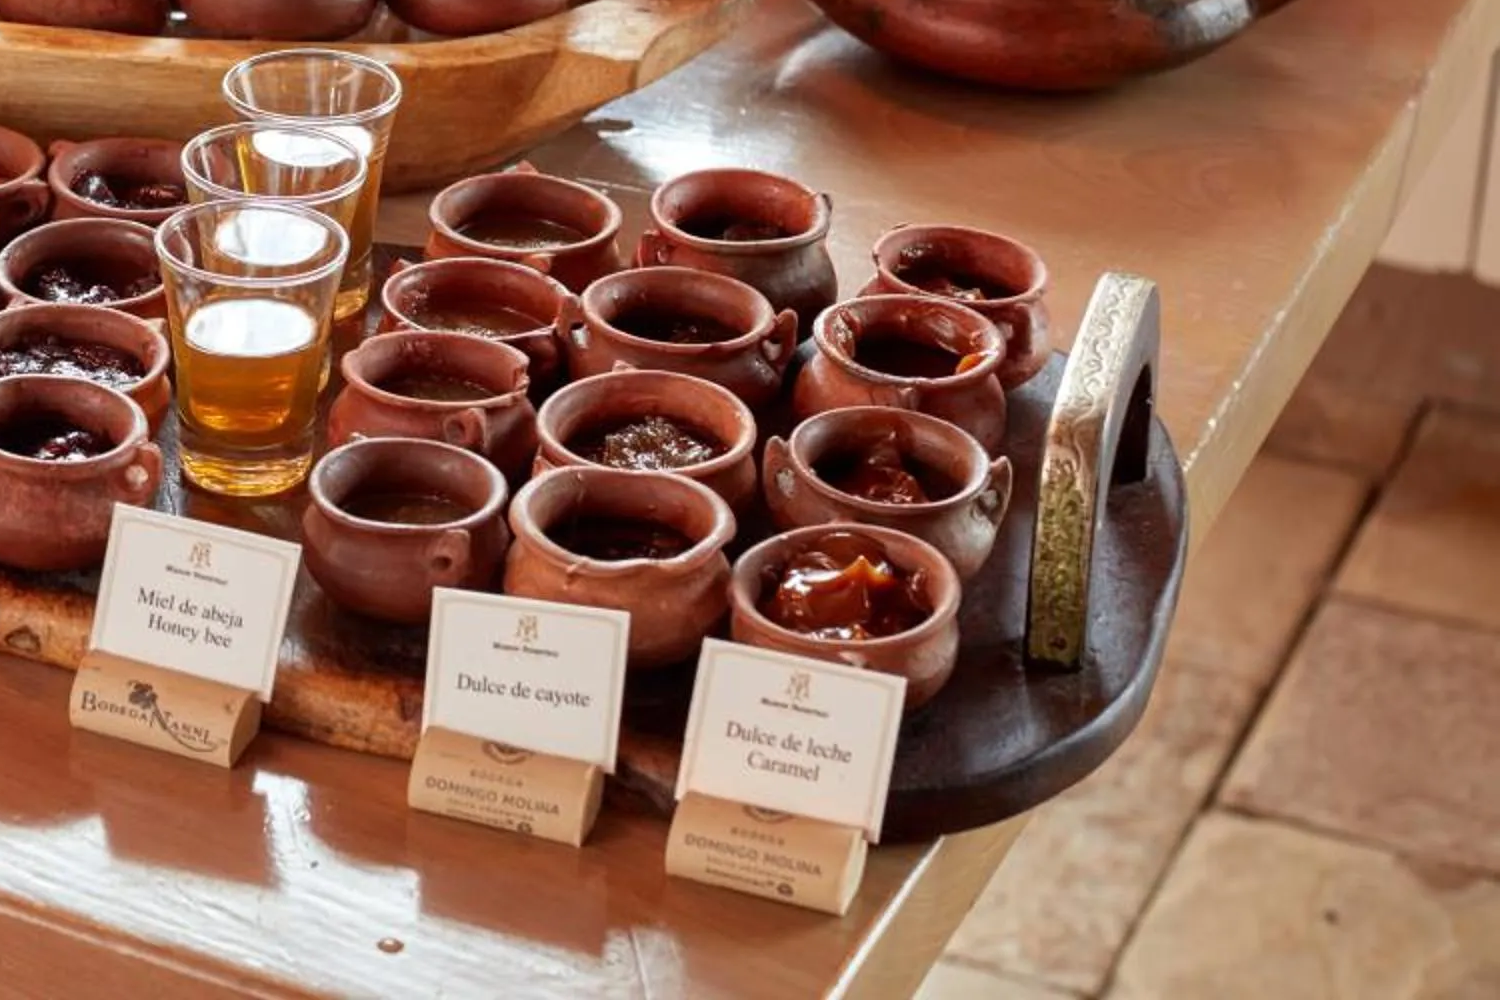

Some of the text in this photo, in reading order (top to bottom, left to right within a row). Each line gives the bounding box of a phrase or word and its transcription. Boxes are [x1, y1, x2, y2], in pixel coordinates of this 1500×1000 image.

[137, 586, 244, 629] Miel de abeja
[147, 613, 233, 649] Honey bee
[456, 672, 591, 709] Dulce de cayote
[725, 719, 852, 764] Dulce de leche
[747, 750, 820, 782] Caramel
[425, 776, 498, 802] DOMINGO
[502, 794, 559, 815] MOLINA
[684, 832, 758, 860] DOMINGO
[763, 852, 822, 877] MOLINA
